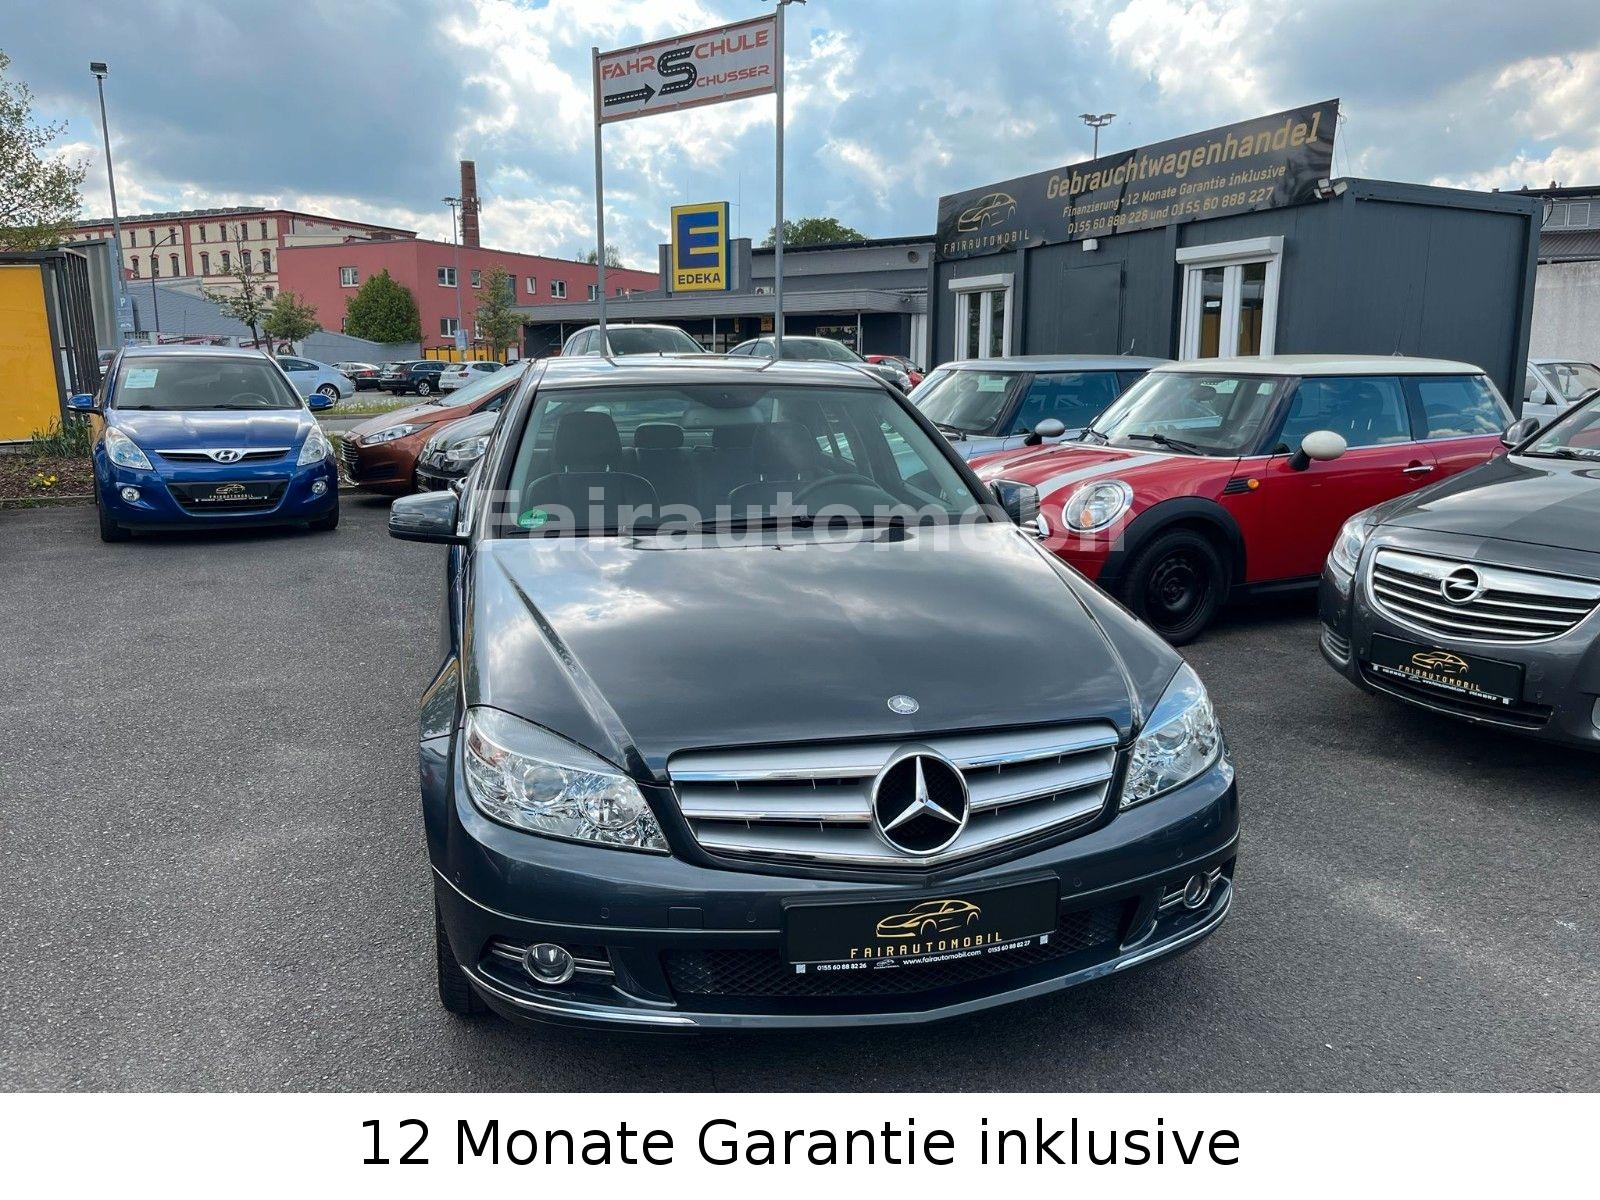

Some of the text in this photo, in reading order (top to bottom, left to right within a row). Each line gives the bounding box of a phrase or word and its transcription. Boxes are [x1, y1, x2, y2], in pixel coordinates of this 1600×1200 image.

[1046, 111, 1322, 199] Gebrauchtwagenhandel
[1062, 164, 1286, 218] Finanzierung 12 Monate Garantie inklusive
[1067, 220, 1091, 234] 0155
[1150, 205, 1169, 220] und
[1171, 200, 1200, 216] 0155
[1248, 186, 1275, 204] 227
[943, 229, 1030, 254] FAIRAUTOMOBIL
[678, 273, 721, 285] EDEKA
[1399, 665, 1481, 692] FAIRAUTOMOBIL
[850, 932, 1003, 959] FAIRAUTOMOBIL
[902, 949, 982, 965] www.fairautomobil.com
